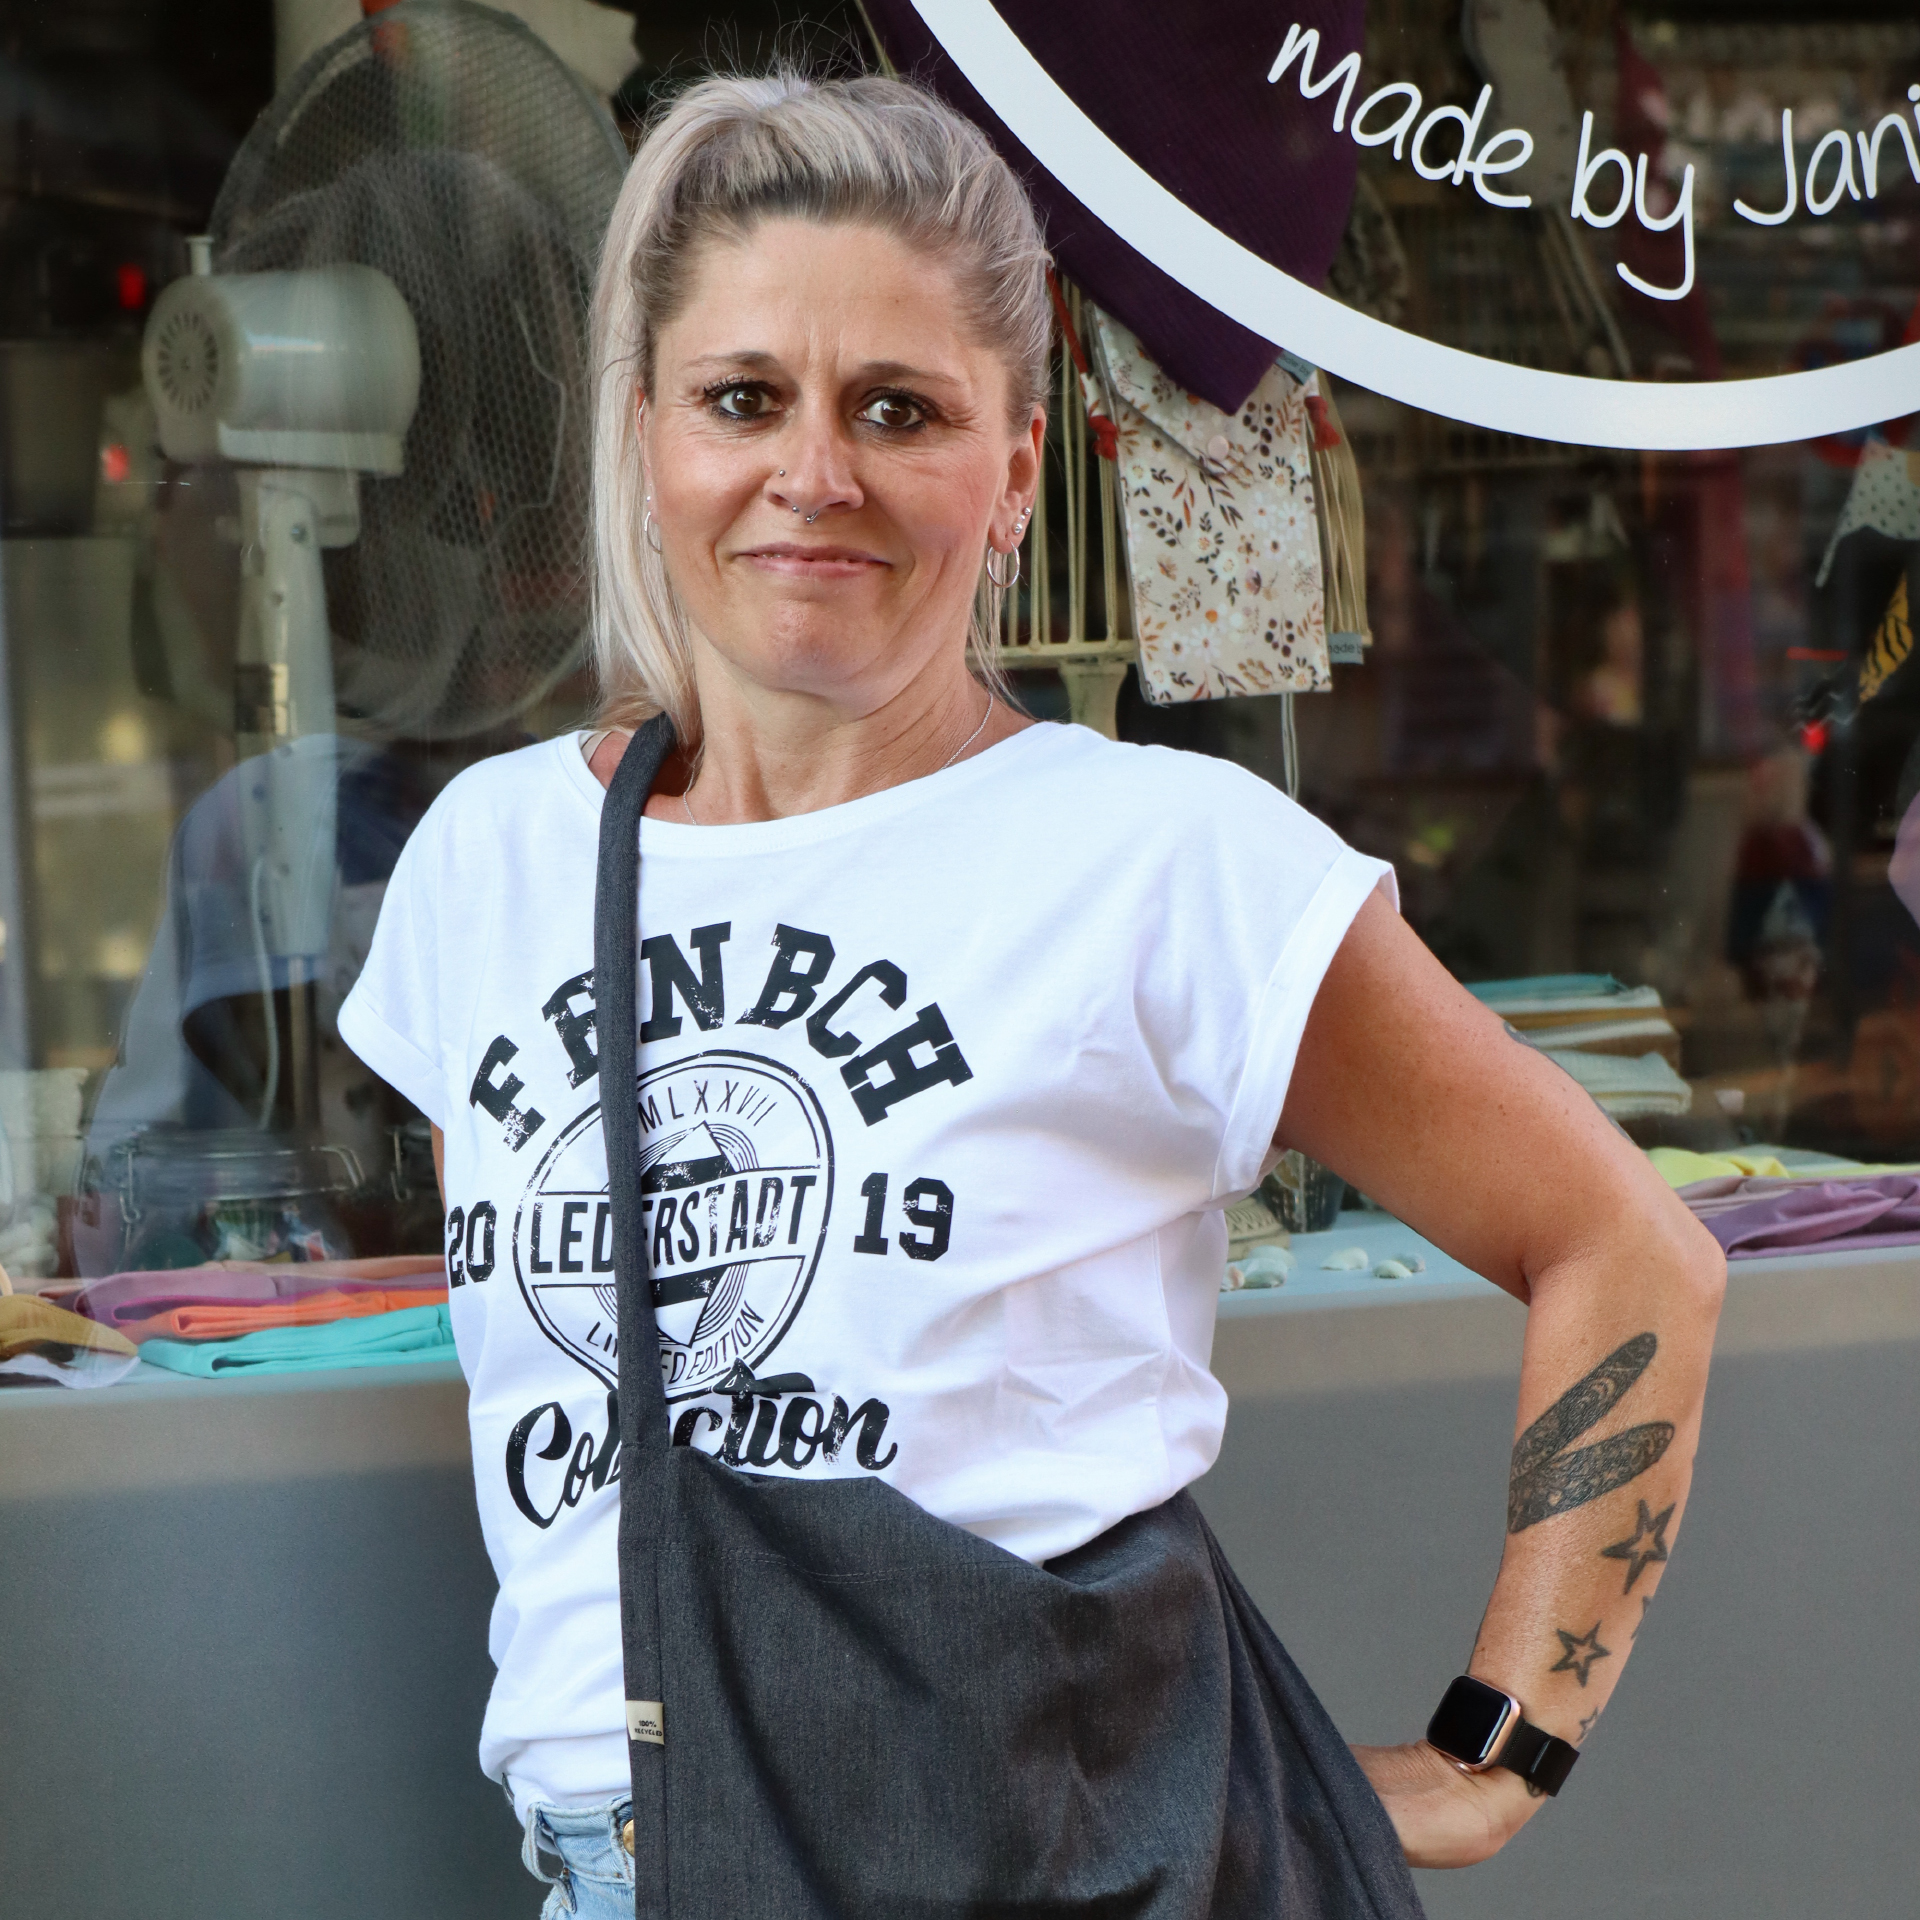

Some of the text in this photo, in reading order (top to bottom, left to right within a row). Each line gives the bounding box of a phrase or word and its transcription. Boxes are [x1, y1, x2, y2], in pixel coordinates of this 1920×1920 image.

[1266, 23, 1534, 209] made
[1570, 110, 1695, 301] by
[447, 1172, 954, 1289] 20 19
[685, 1300, 764, 1381] EDITION
[634, 1727, 663, 1737] RECYCLED
[638, 1719, 657, 1728] 100%
